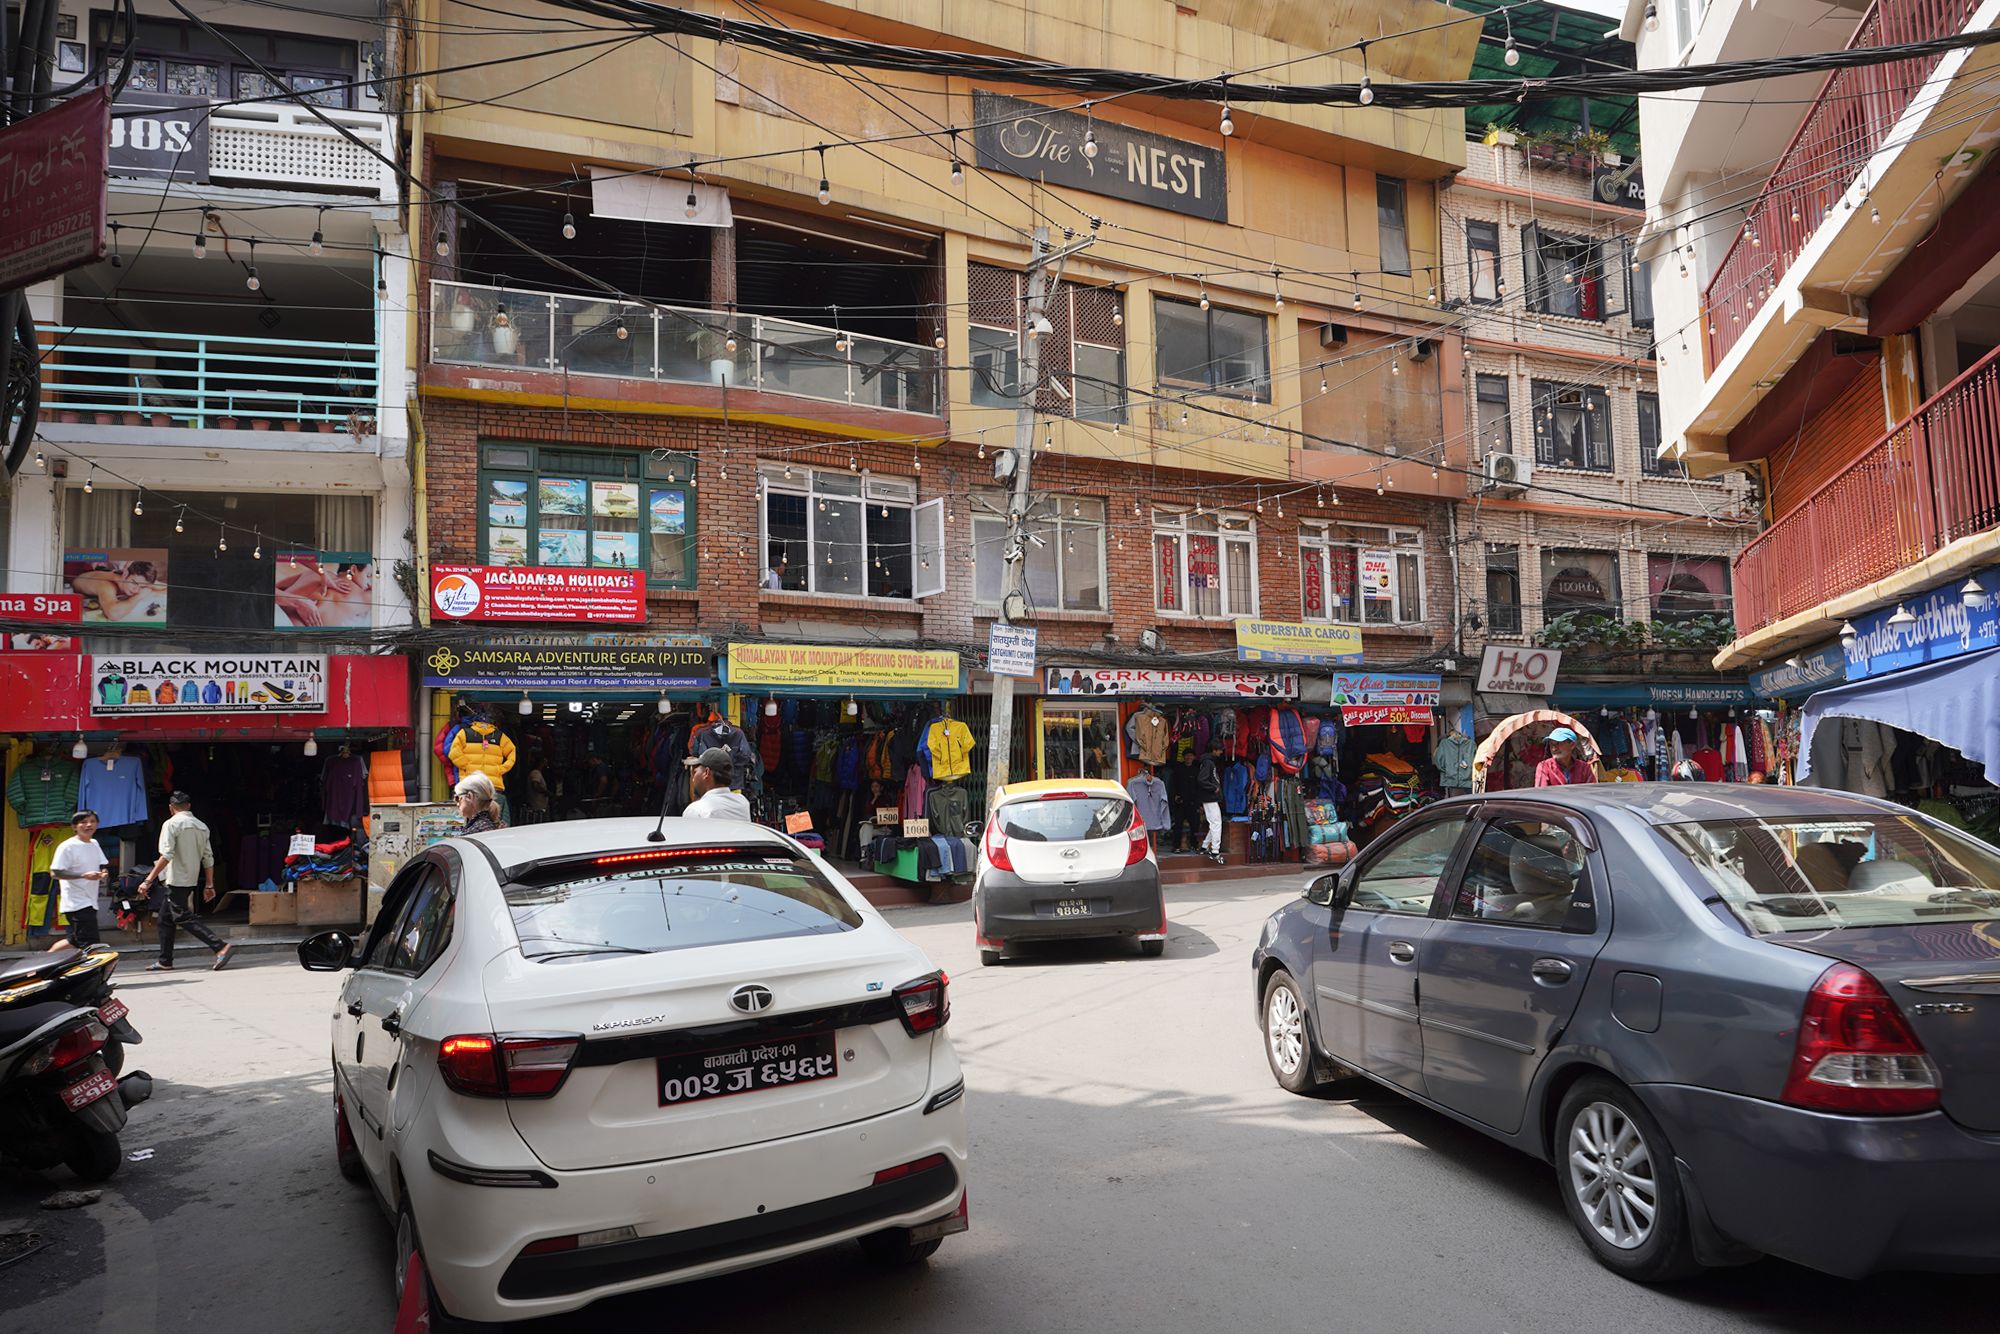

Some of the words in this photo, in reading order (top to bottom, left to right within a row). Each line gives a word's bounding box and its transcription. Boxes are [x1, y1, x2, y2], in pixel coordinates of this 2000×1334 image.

[999, 117, 1071, 164] The
[1127, 142, 1205, 199] NEST
[1365, 561, 1387, 573] DHL
[484, 572, 565, 586] JAGADAMBA
[568, 575, 629, 588] HOLIDAYS
[1188, 573, 1219, 589] FedEx
[1305, 552, 1321, 610] CARGO
[33, 596, 72, 615] Spa
[1250, 624, 1312, 638] SUPERSTAR
[1315, 628, 1350, 640] CARGO
[464, 651, 531, 663] SAMSARA
[535, 651, 616, 663] ADVENTURE
[620, 652, 655, 663] GEAR
[658, 652, 677, 666] (P.)
[681, 653, 706, 664] LTD.
[736, 648, 787, 664] HIMALAYAN
[789, 650, 807, 665] YAK
[808, 651, 852, 667] MOUNTAIN
[855, 652, 895, 668] TREKKING
[898, 655, 923, 669] STORE
[123, 661, 197, 674] BLACK
[205, 660, 320, 673] MOUNTAIN
[448, 678, 503, 686] Manufacture,
[594, 679, 620, 687] Repair
[657, 679, 697, 687] Equipment
[1095, 670, 1151, 681] G.R.K
[1156, 671, 1261, 683] TRADERS
[1650, 687, 1682, 700] YUGESH
[1685, 688, 1744, 700] HANDICRAFTS
[1343, 711, 1358, 722] SALE
[1359, 709, 1373, 723] SALE
[1374, 707, 1388, 722] SALE
[1390, 712, 1410, 722] 50%
[1411, 711, 1430, 719] Discount
[879, 813, 898, 822] 1500
[905, 825, 928, 835] 1000
[704, 1049, 748, 1069] बागमती
[725, 1066, 755, 1091] ज
